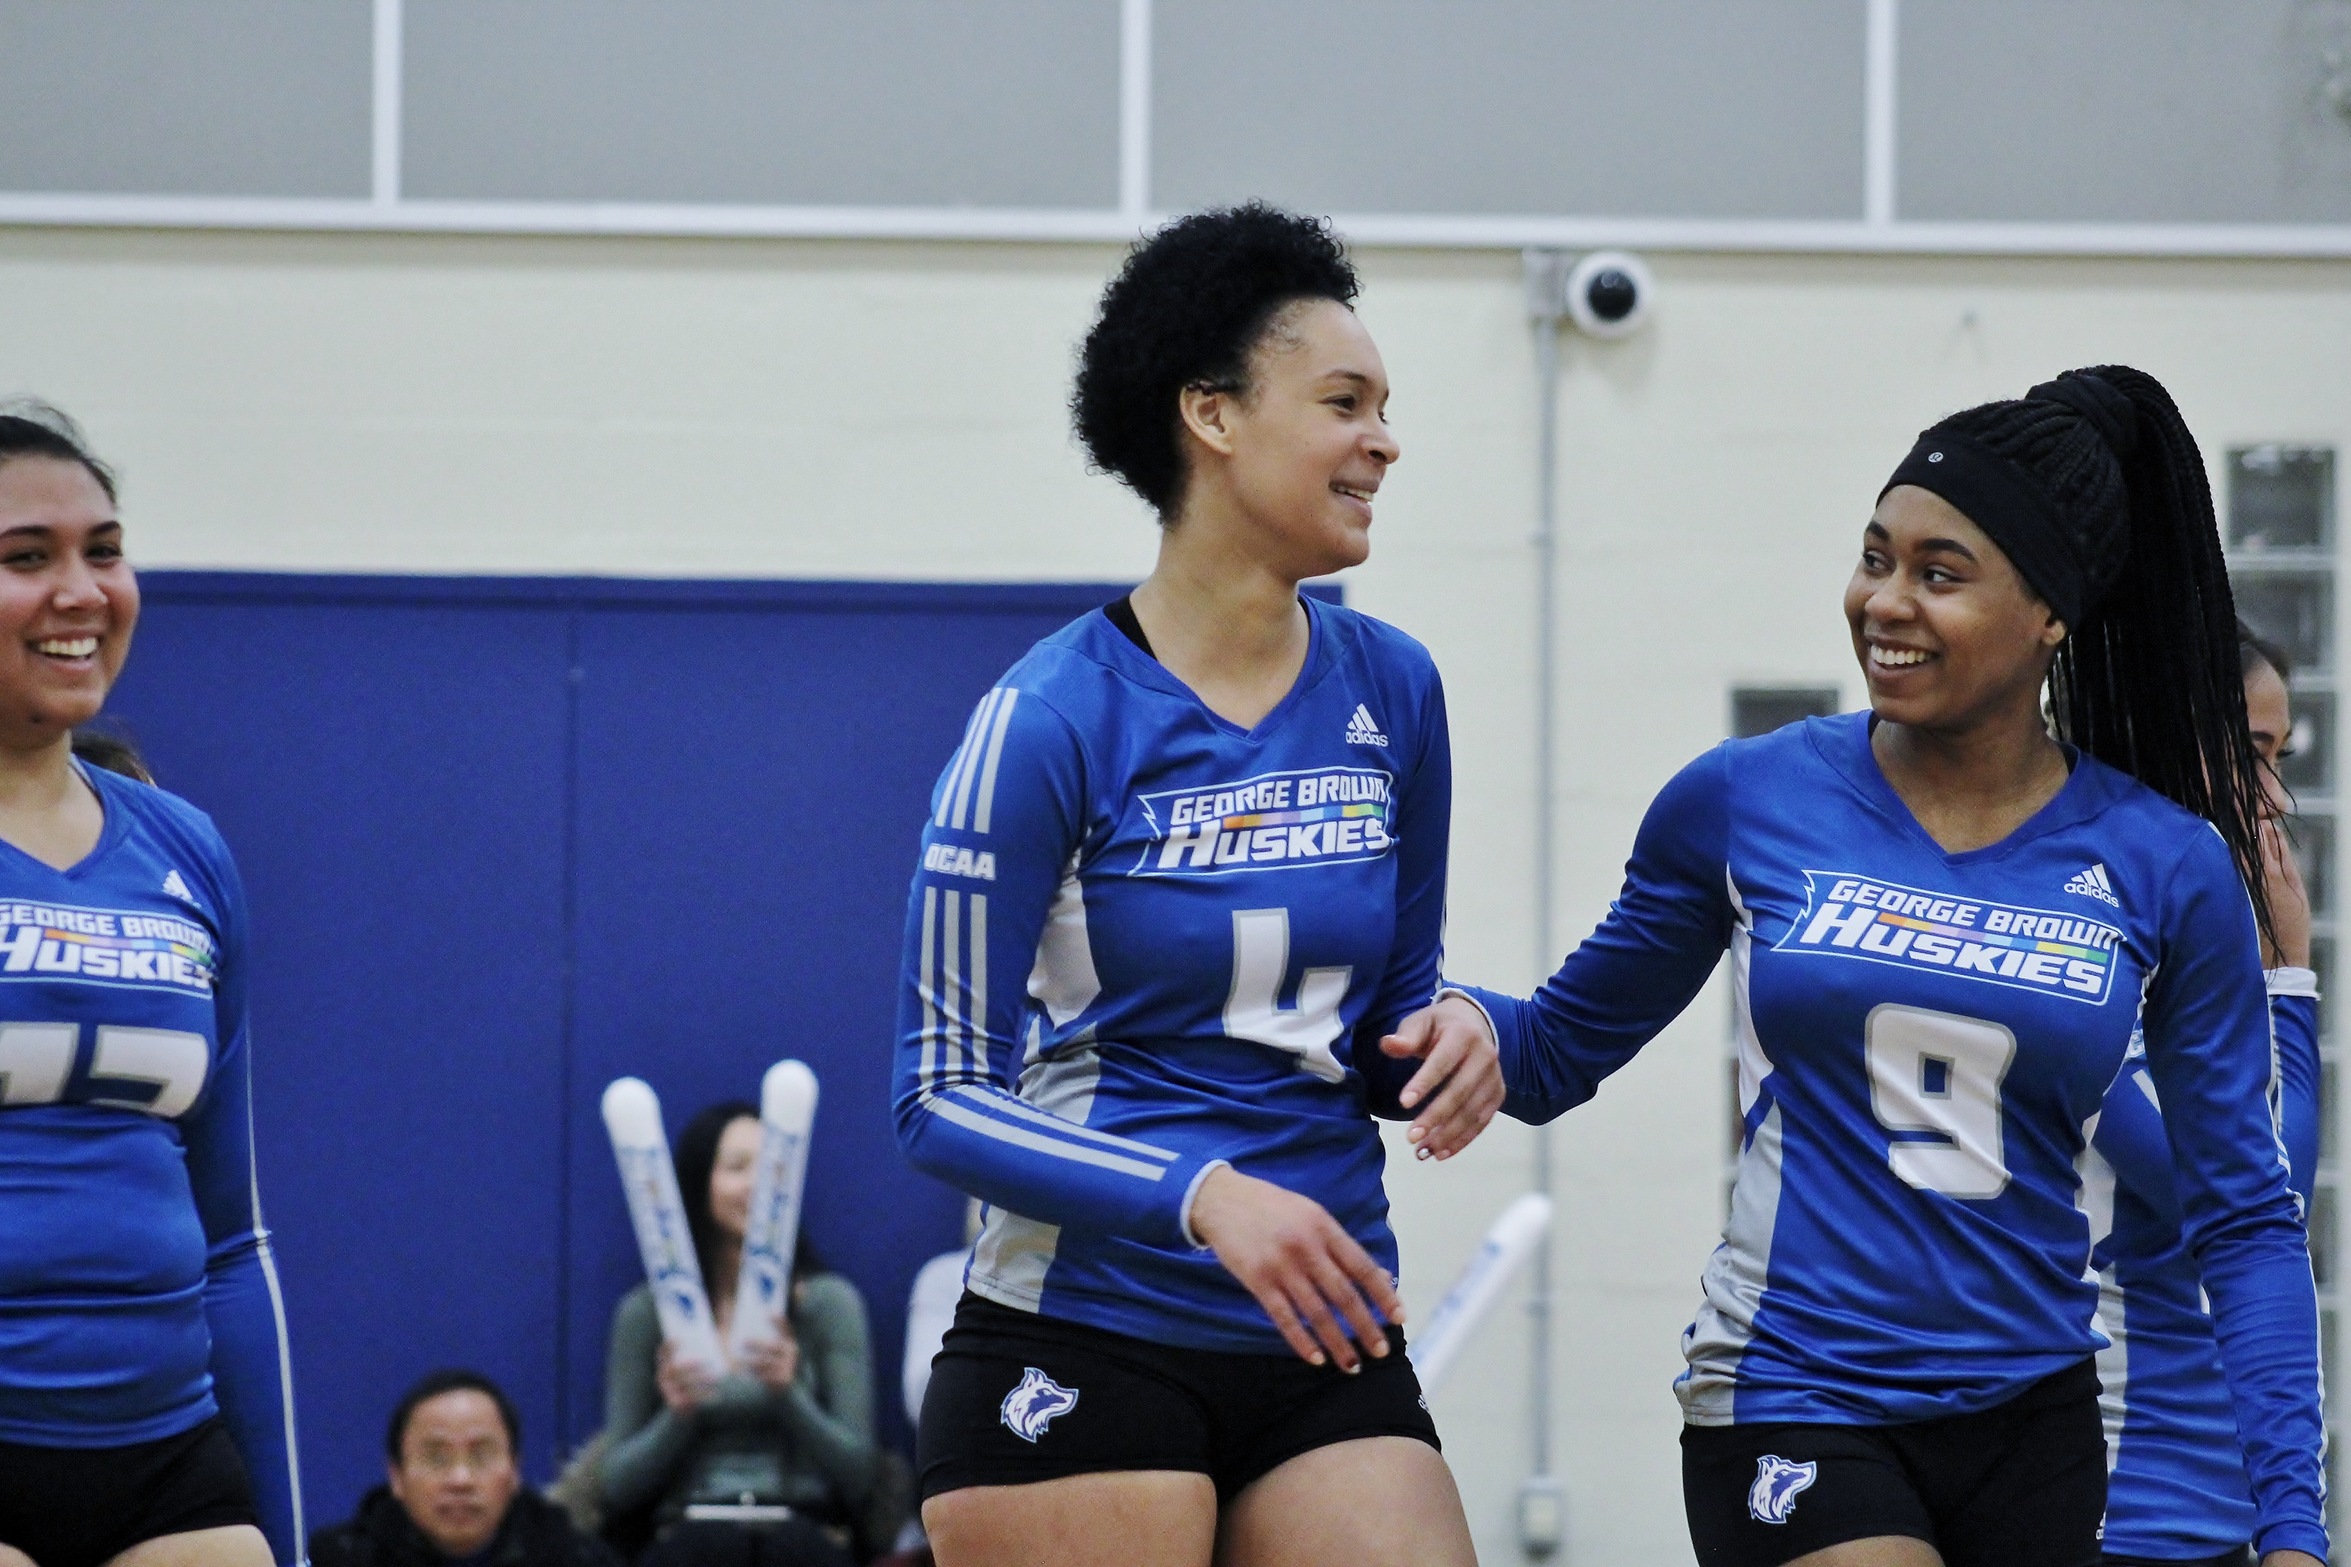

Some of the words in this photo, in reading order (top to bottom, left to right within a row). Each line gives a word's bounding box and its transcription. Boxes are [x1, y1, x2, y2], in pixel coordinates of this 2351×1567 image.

[1345, 729, 1389, 747] adidas
[1170, 780, 1292, 826] GEORGE
[1297, 775, 1386, 806] BROWN
[923, 842, 996, 881] OCAA
[1157, 818, 1390, 869] HUSKIES
[1827, 880, 1981, 927] GEORGE
[1984, 912, 2119, 950] BROWN
[2063, 882, 2119, 908] adidas
[1799, 902, 2106, 994] HUSKIES
[1222, 907, 1353, 1084] 4
[1865, 1002, 2017, 1200] 9
